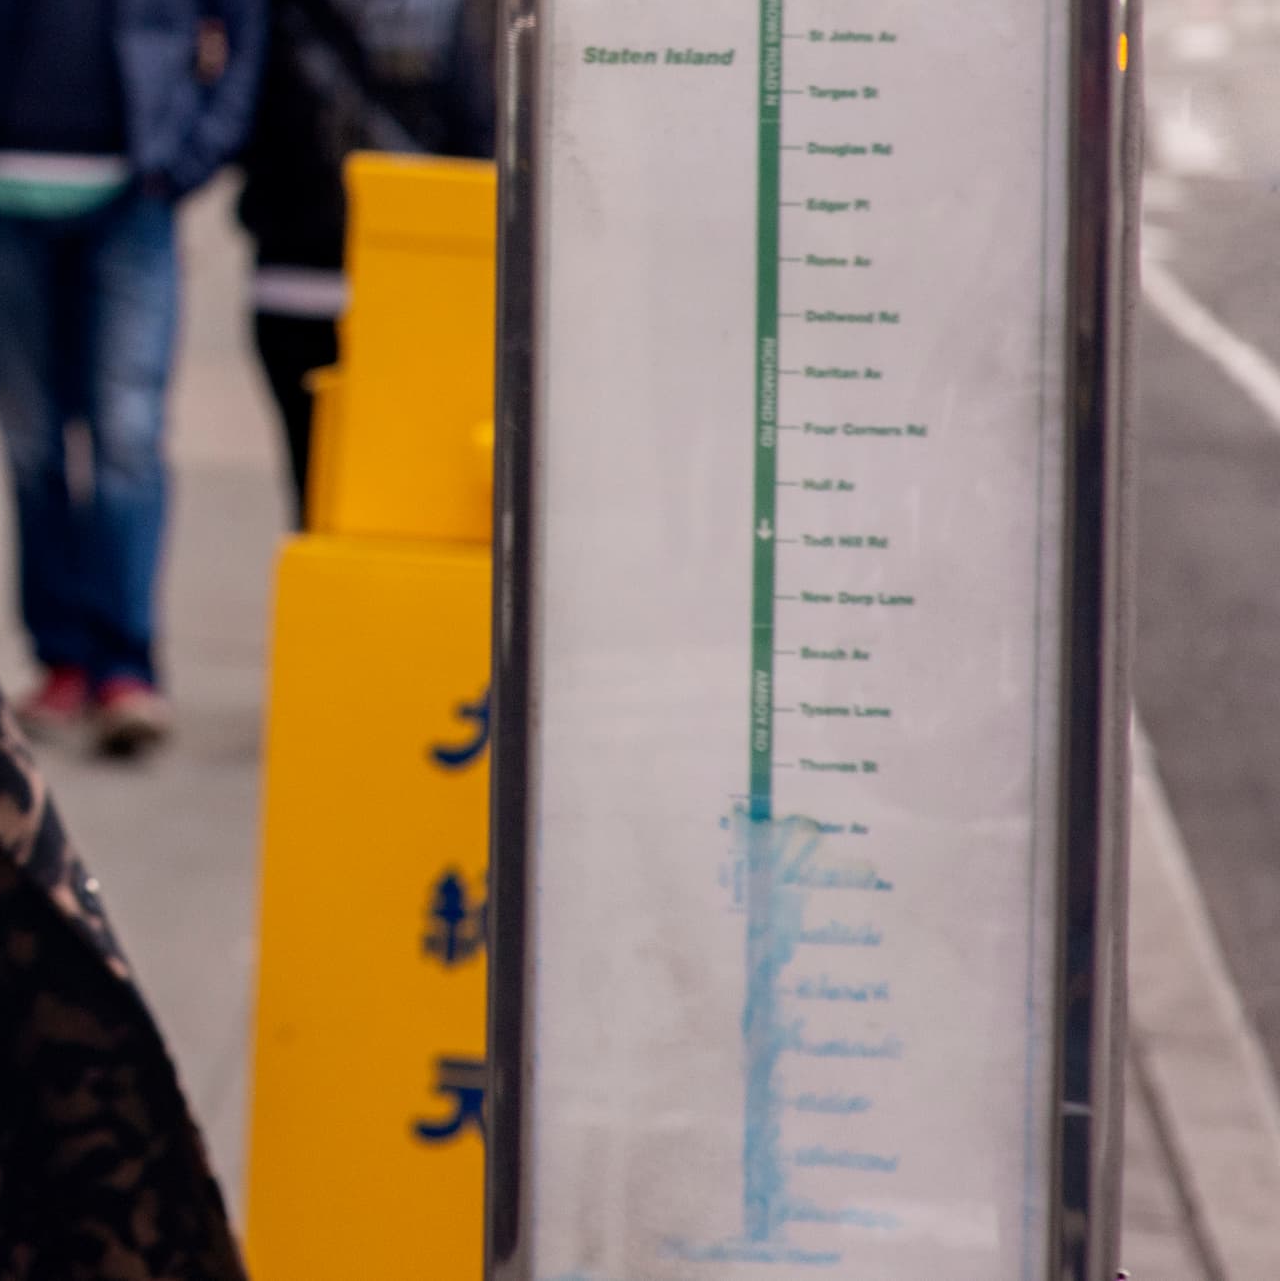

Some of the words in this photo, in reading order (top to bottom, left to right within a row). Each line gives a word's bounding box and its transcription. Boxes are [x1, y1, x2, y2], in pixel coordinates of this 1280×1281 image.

[809, 30, 824, 42] St
[829, 30, 874, 43] Johns
[878, 30, 896, 43] Av
[583, 46, 658, 65] Staten
[664, 48, 735, 66] Island
[765, 46, 779, 90] ROAD
[862, 86, 878, 99] St
[807, 142, 868, 157] Douglas
[872, 143, 893, 156] Rd
[852, 255, 872, 268] Av
[878, 311, 900, 325] Rd
[760, 336, 776, 422] RICHMOND
[864, 367, 882, 380] Av
[760, 424, 774, 448] RD
[804, 422, 838, 436] Four
[842, 423, 903, 437] Corners
[906, 424, 928, 438] Rd
[836, 479, 855, 491] Av
[838, 536, 863, 549] Hill
[866, 536, 888, 550] Rd
[801, 591, 833, 604] New
[838, 592, 875, 607] Dorp
[878, 593, 915, 607] Lane
[851, 648, 870, 661] Av
[754, 669, 769, 726] AMBOY
[854, 705, 892, 718] Lane
[754, 728, 768, 752] RD
